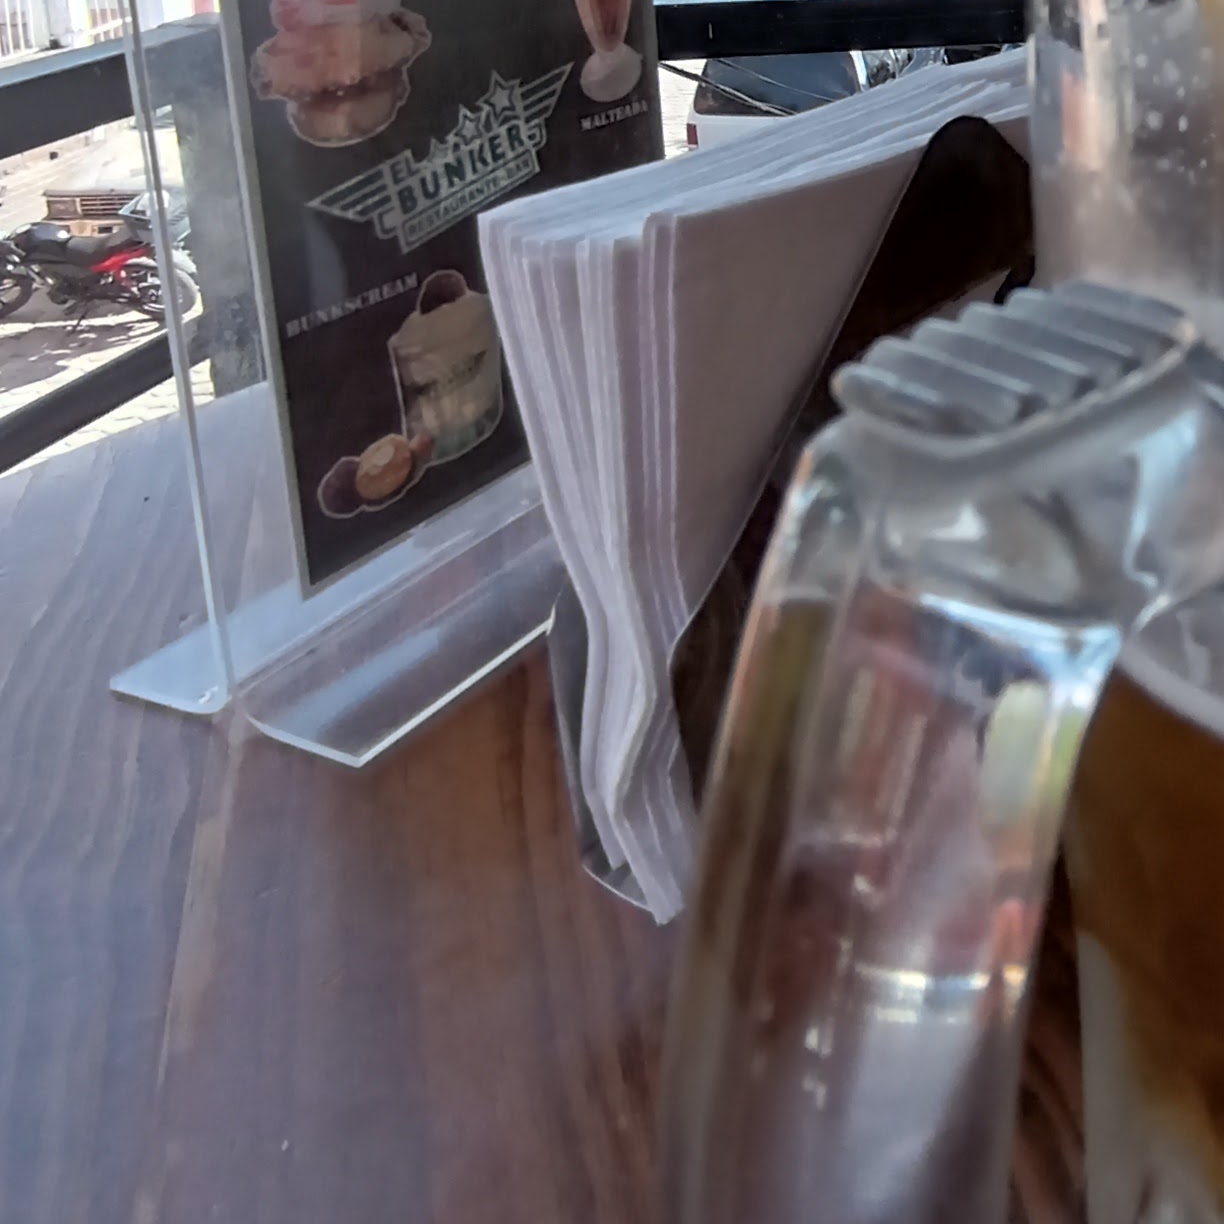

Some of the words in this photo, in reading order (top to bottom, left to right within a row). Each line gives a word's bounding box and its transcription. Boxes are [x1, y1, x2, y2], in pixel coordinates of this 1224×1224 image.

[580, 99, 649, 132] MALTEADA
[389, 155, 421, 185] EL
[397, 123, 525, 215] BUNKER
